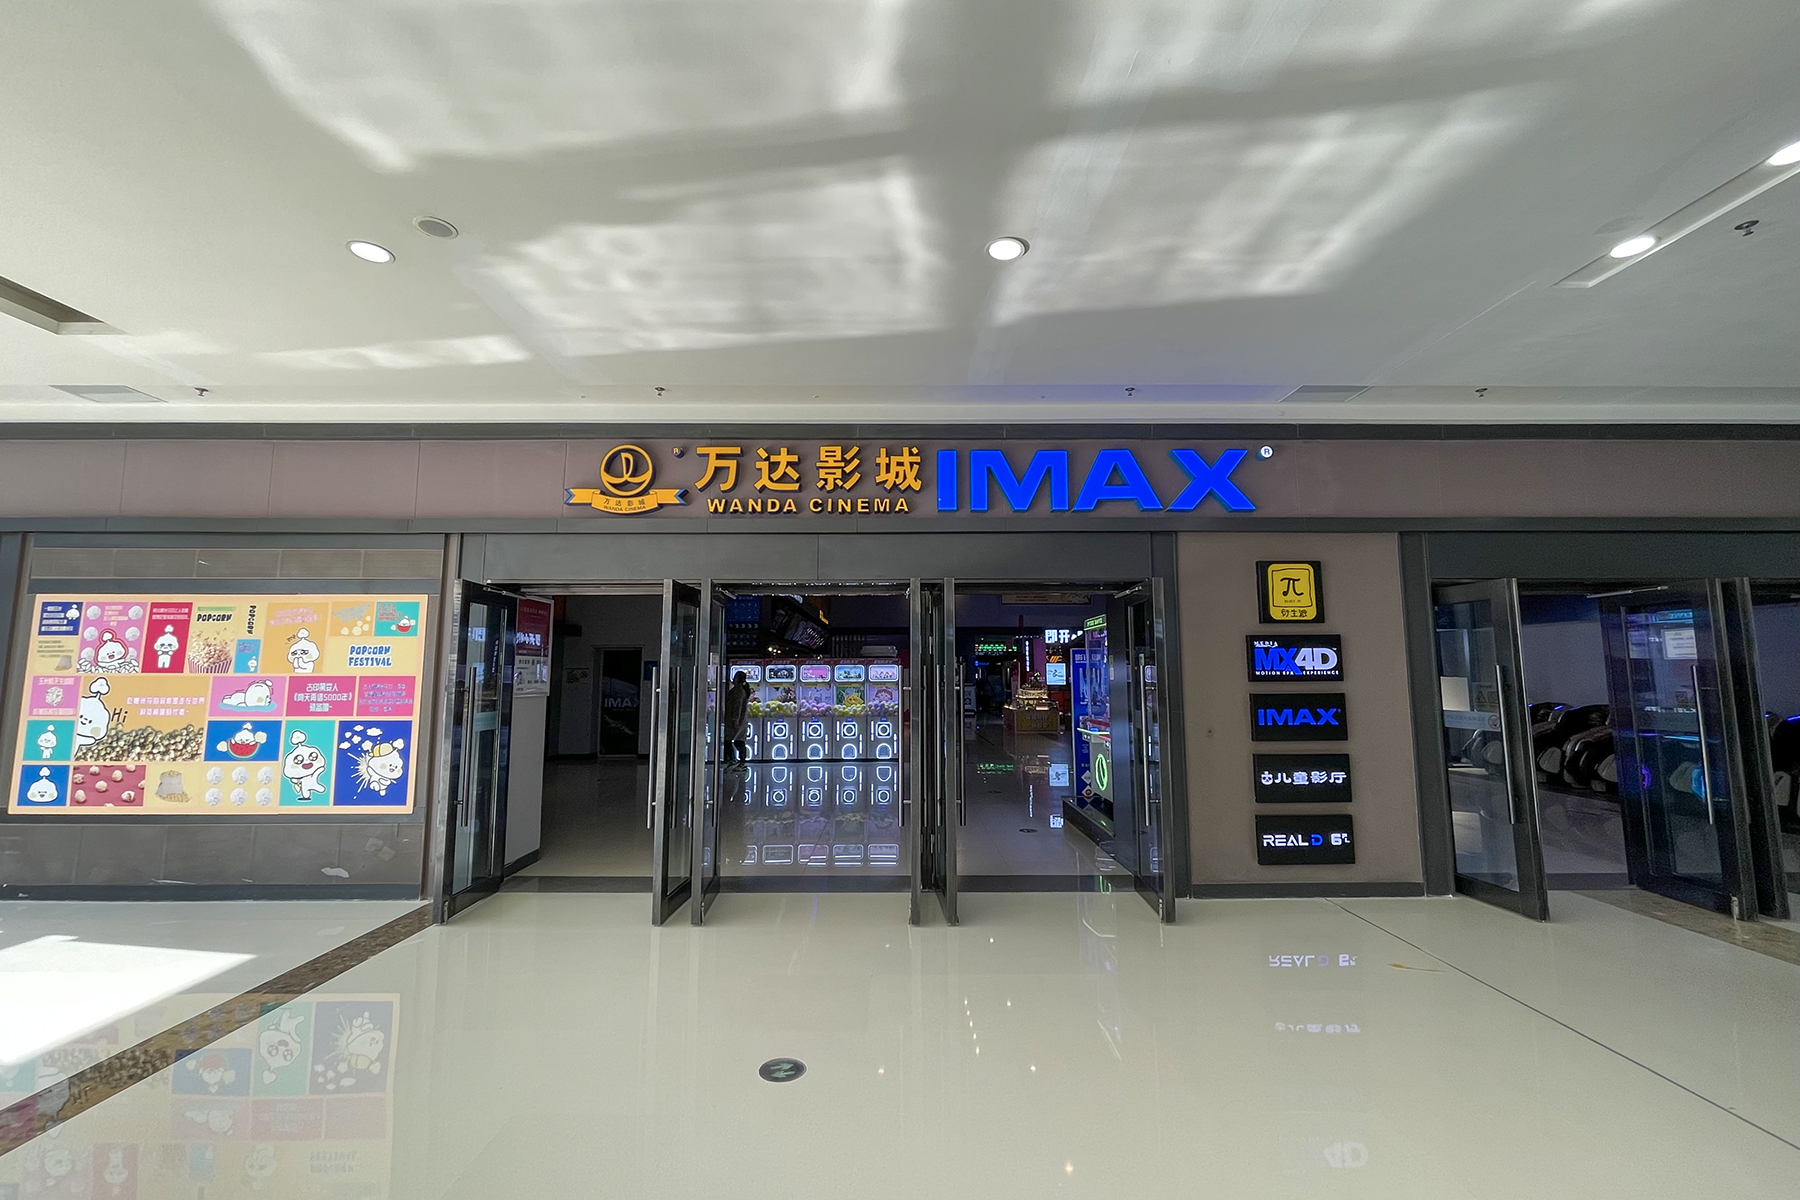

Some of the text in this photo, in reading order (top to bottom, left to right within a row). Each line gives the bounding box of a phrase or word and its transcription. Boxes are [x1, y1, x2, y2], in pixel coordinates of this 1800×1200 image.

[695, 445, 922, 493] 万达影城
[936, 448, 1257, 512] IMAX
[707, 497, 910, 514] WANDA CINEMA
[348, 656, 392, 668] FESTIVAL
[1258, 708, 1339, 726] IMAX
[1274, 770, 1347, 785] 儿童影厅
[1263, 834, 1309, 846] REAL
